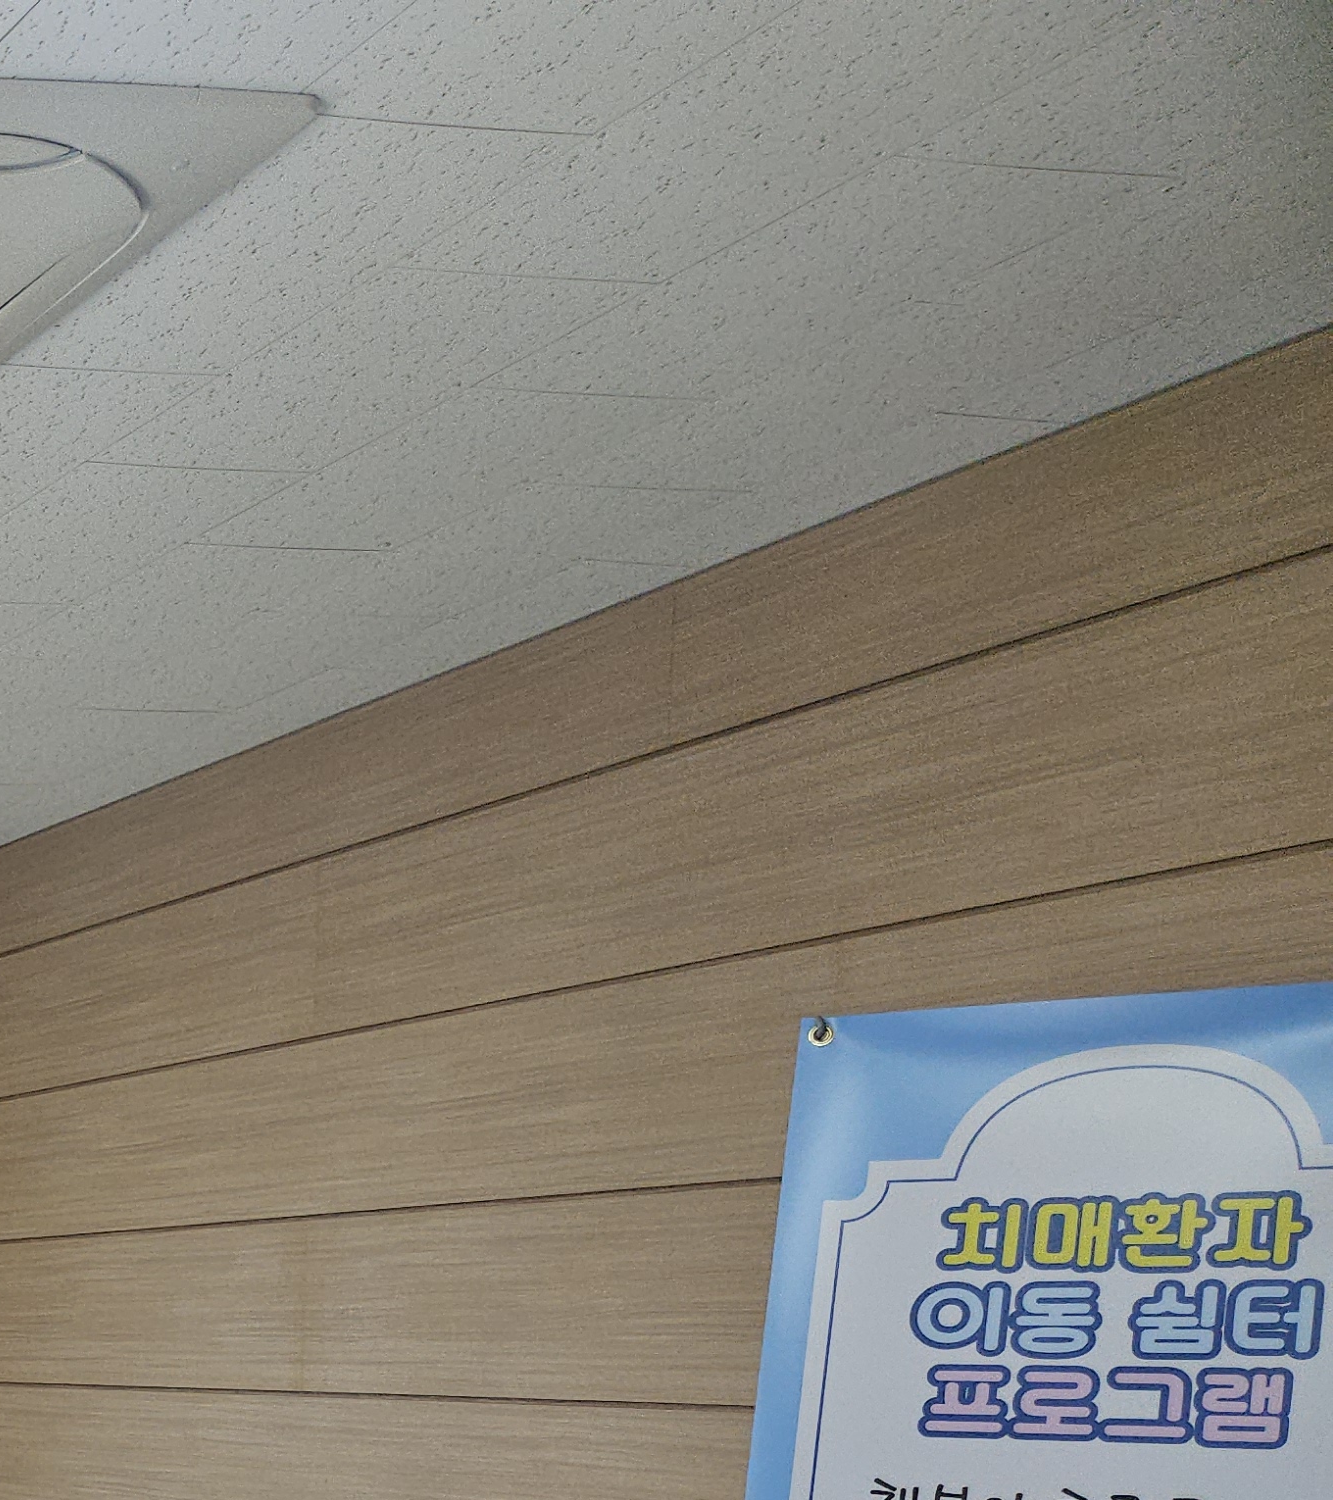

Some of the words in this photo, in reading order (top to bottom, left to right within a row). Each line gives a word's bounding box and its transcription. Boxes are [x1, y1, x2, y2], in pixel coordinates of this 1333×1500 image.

[936, 1190, 1313, 1274] 치매환자
[910, 1281, 1102, 1359] 이동
[1129, 1278, 1325, 1360] 쉼터
[918, 1364, 1294, 1450] 프로그램
